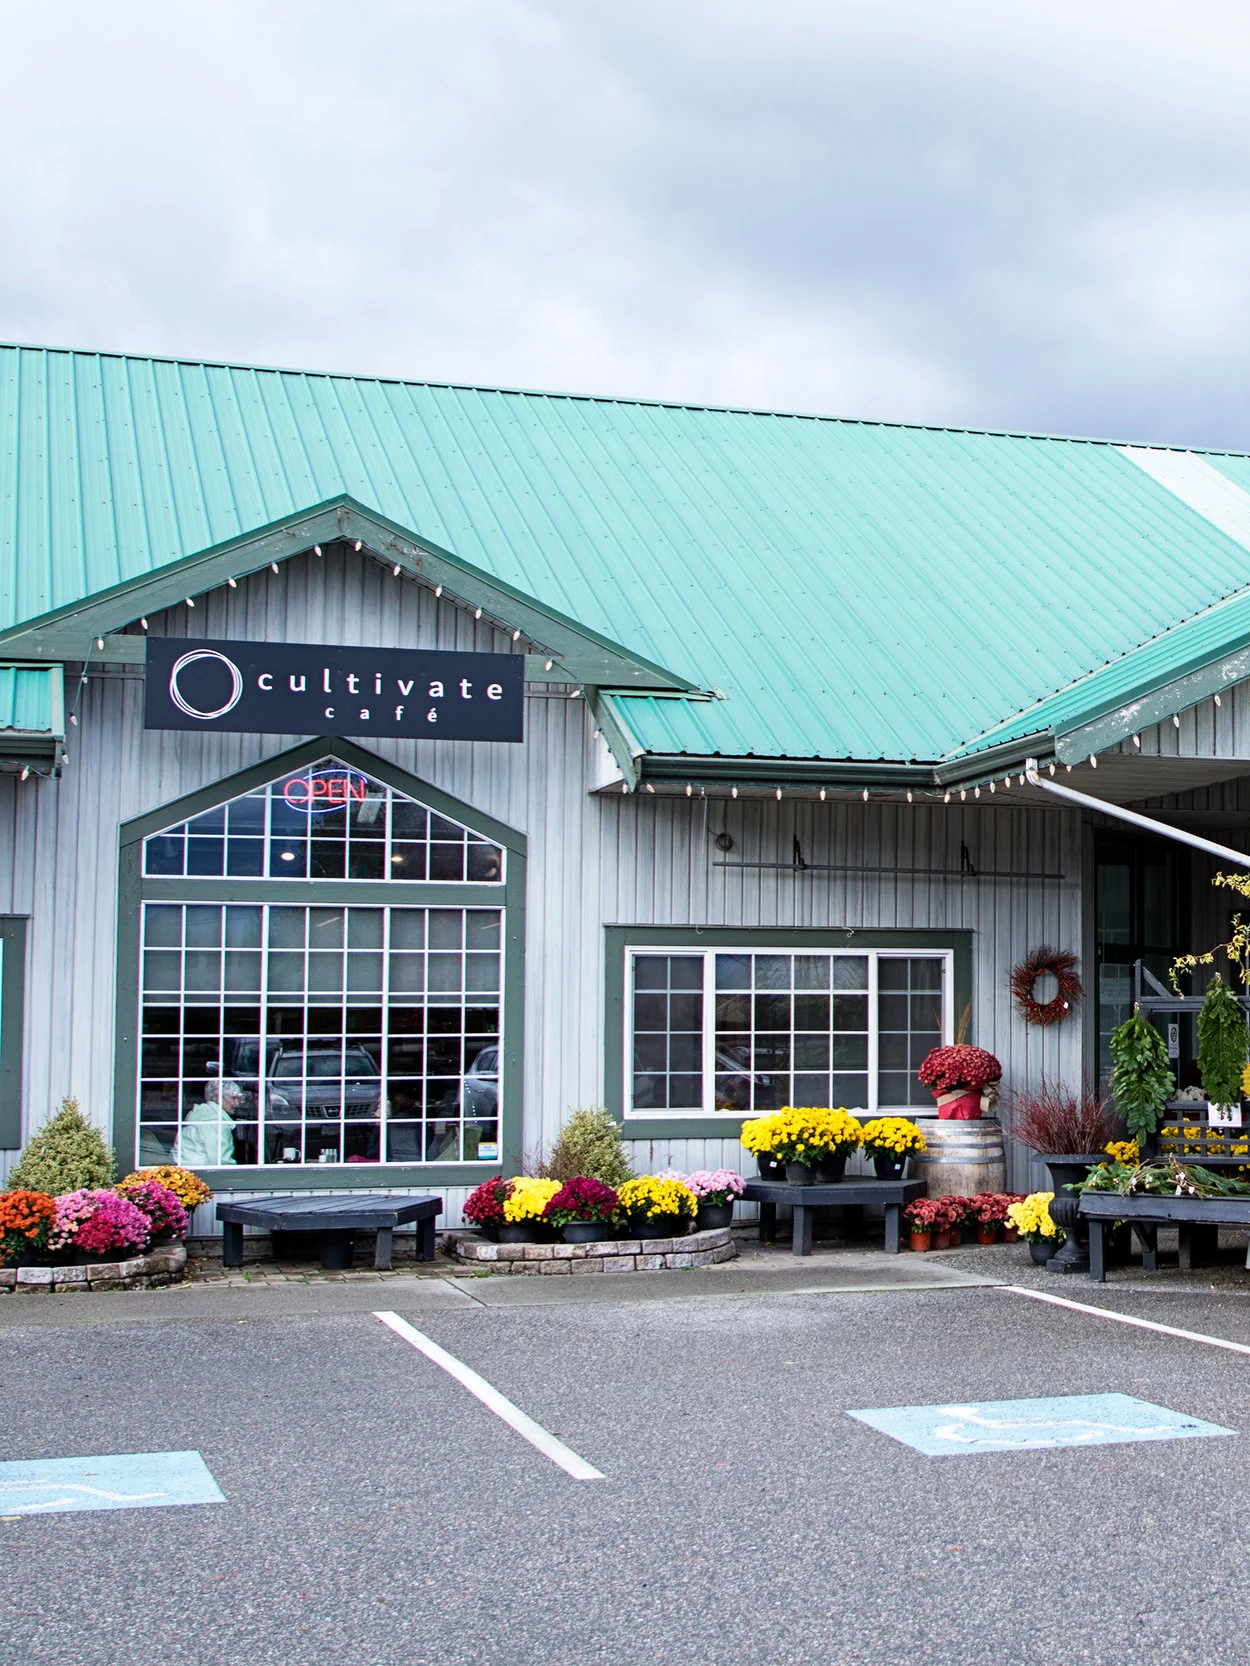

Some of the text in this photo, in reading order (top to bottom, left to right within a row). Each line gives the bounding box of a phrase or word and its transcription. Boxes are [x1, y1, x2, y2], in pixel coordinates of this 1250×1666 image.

[257, 668, 503, 700] cultivate
[324, 705, 438, 722] café
[283, 778, 366, 805] OPEN
